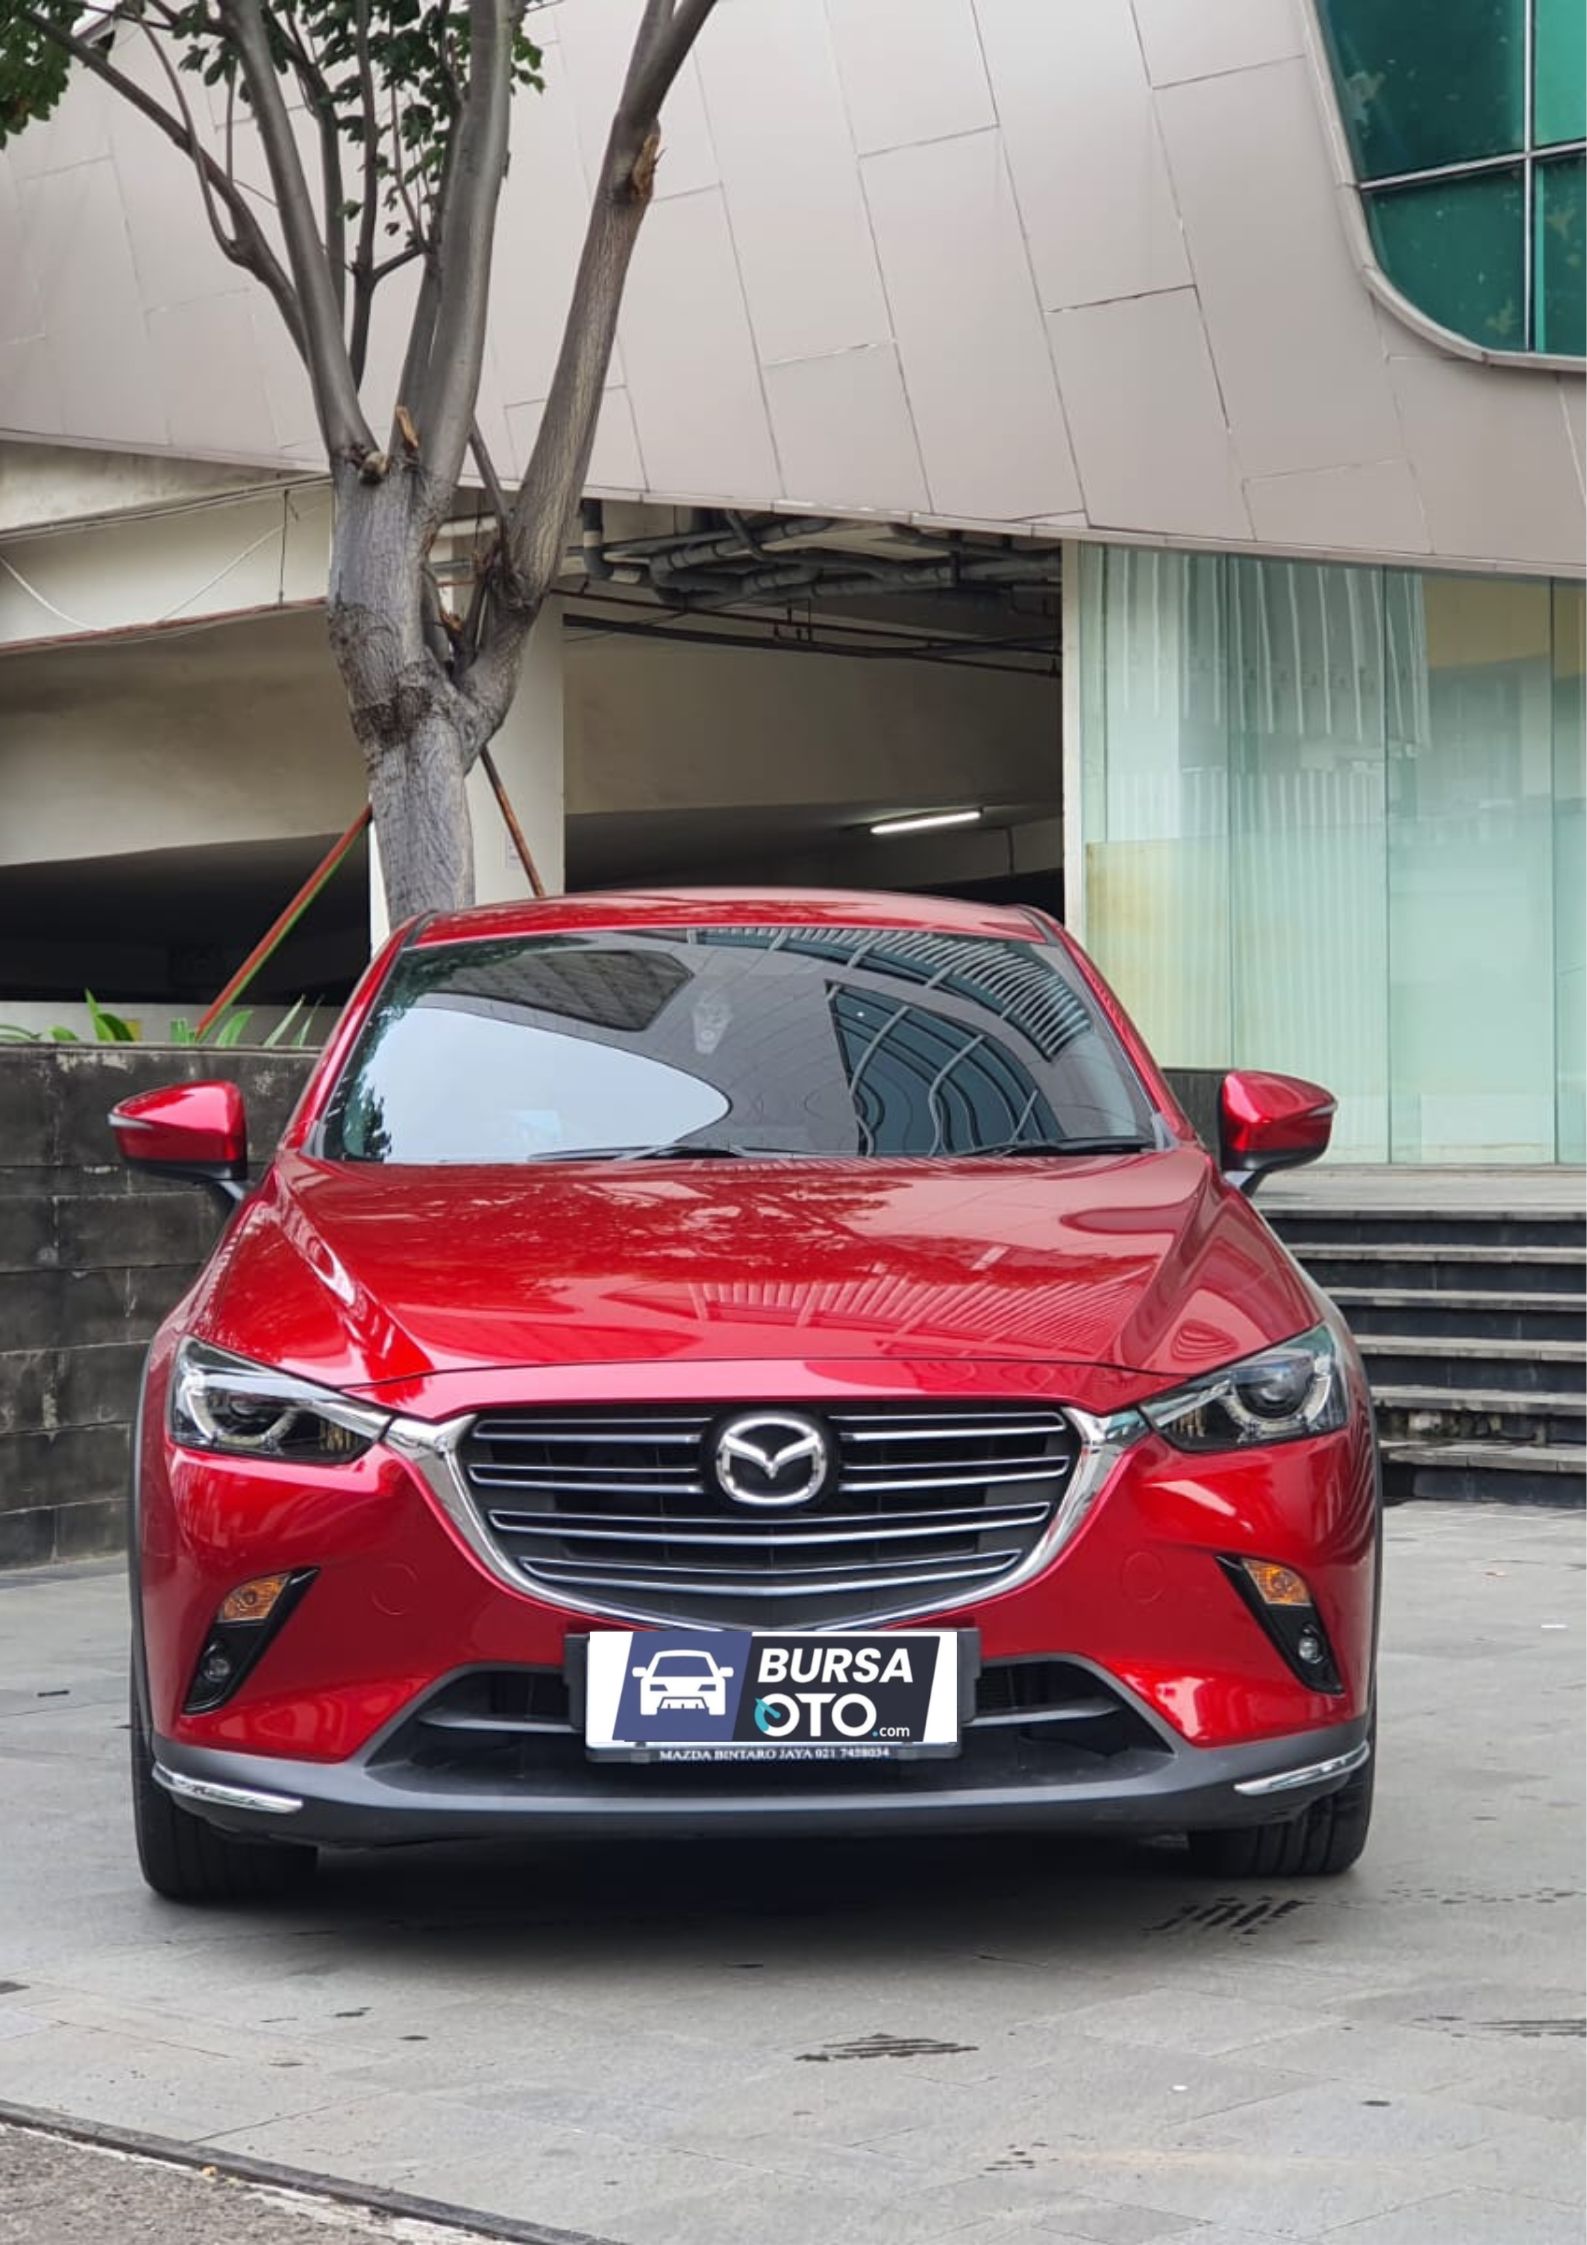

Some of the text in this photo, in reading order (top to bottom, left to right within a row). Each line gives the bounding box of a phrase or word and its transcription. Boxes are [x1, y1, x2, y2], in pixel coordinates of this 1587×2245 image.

[659, 1750, 712, 1761] MAZDA
[714, 1749, 777, 1761] BINTARO
[779, 1748, 813, 1760] JAYA
[815, 1748, 836, 1759] 021
